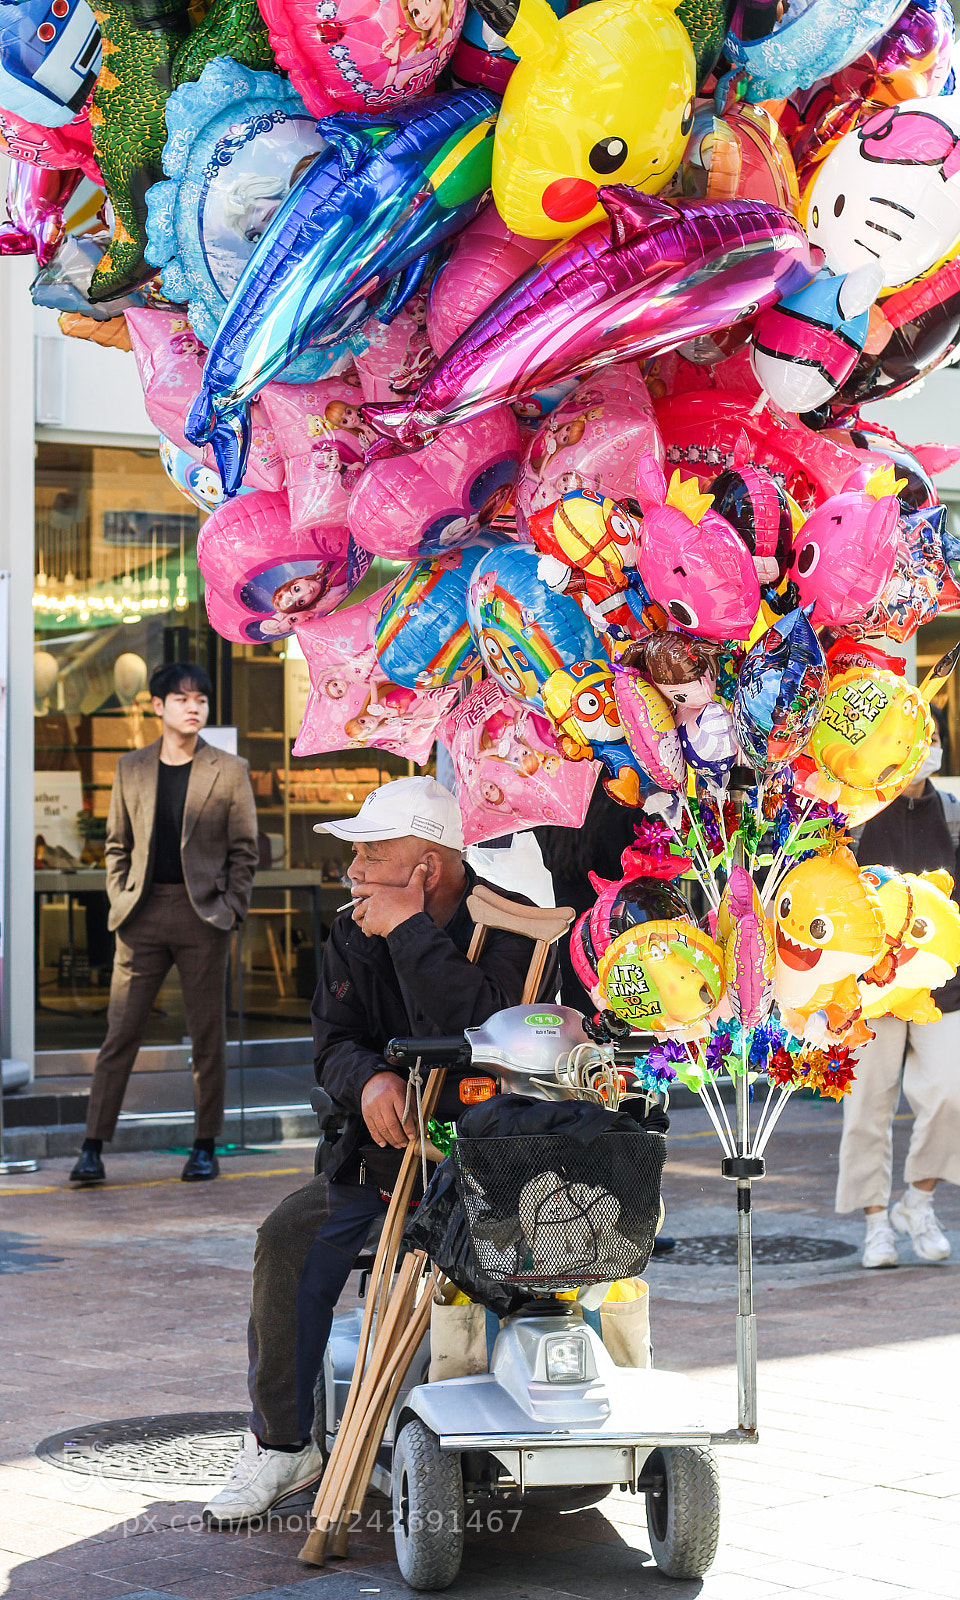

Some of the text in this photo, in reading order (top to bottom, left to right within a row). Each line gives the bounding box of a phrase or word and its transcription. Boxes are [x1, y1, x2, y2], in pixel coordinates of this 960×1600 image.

[842, 686, 880, 723] TIME
[843, 705, 860, 722] TO
[822, 705, 867, 746] PLAY!
[609, 979, 650, 998] TIME
[616, 1001, 662, 1019] PLAY!
[623, 996, 642, 1007] TO
